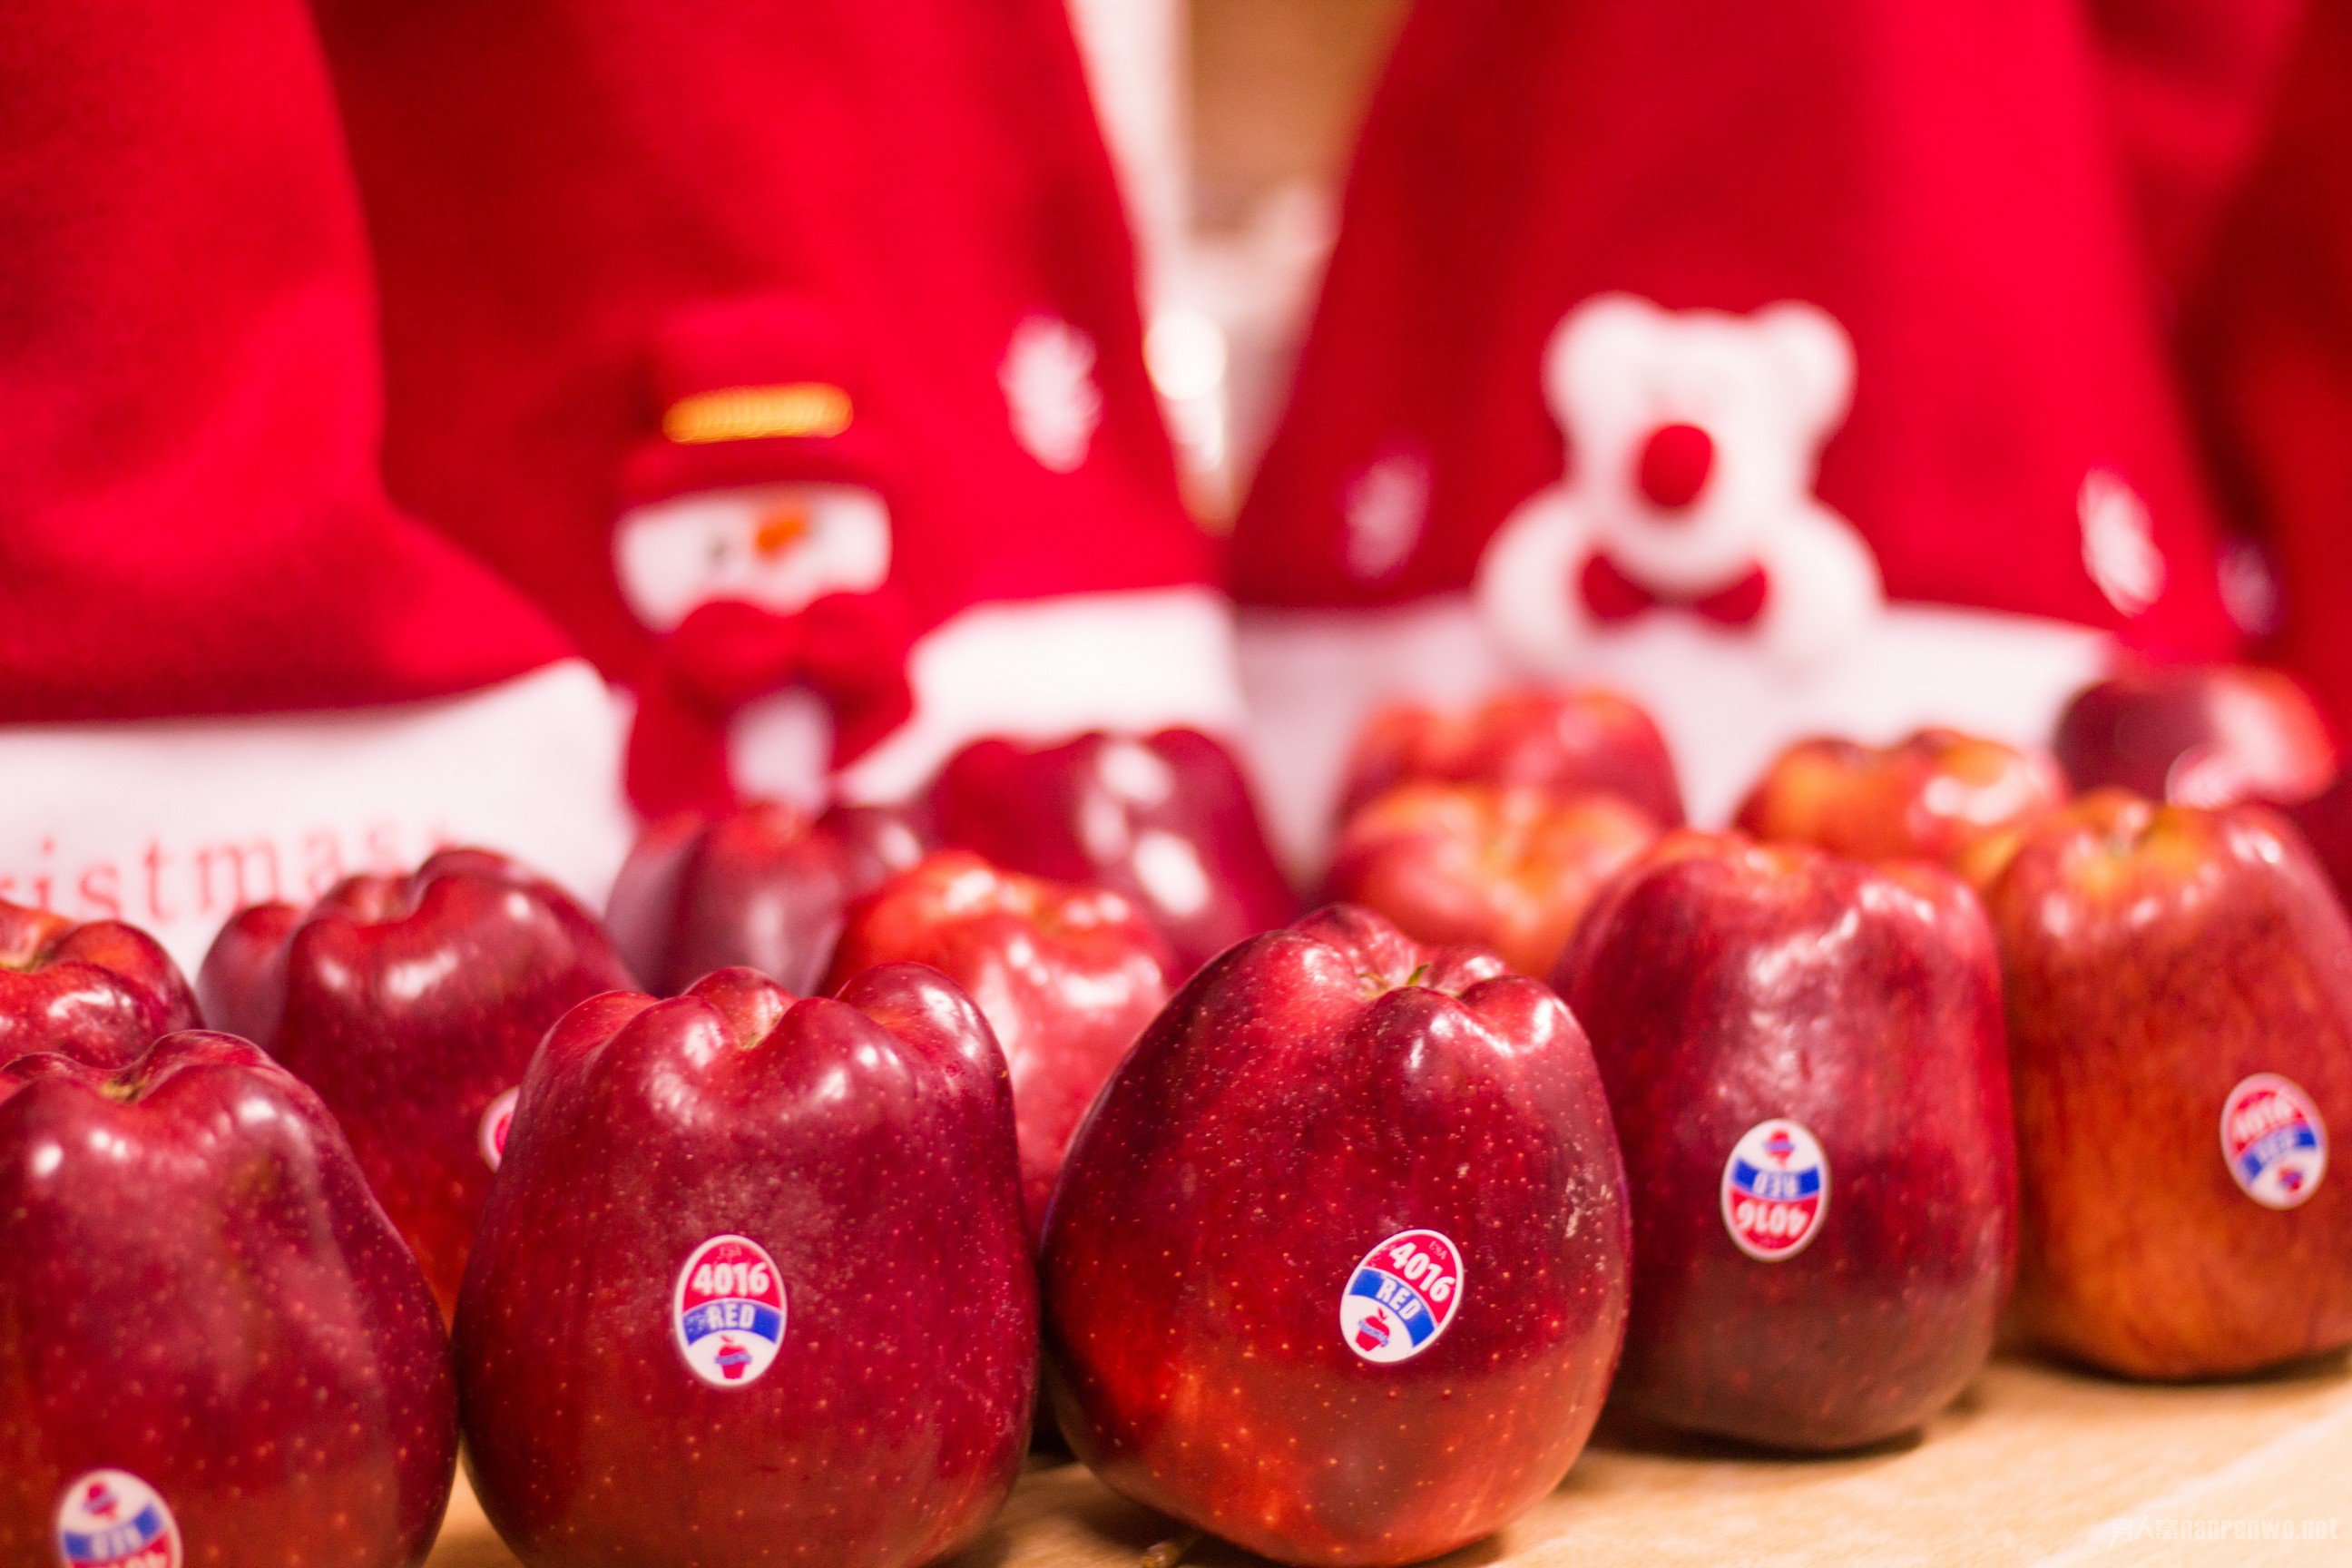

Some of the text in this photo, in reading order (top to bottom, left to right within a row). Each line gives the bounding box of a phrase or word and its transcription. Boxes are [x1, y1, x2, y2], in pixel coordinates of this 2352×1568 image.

[1737, 1200, 1807, 1237] 4016
[692, 1262, 769, 1297] 4016
[1389, 1242, 1455, 1302] 4016
[706, 1304, 755, 1329] RED
[1376, 1278, 1421, 1319] RED
